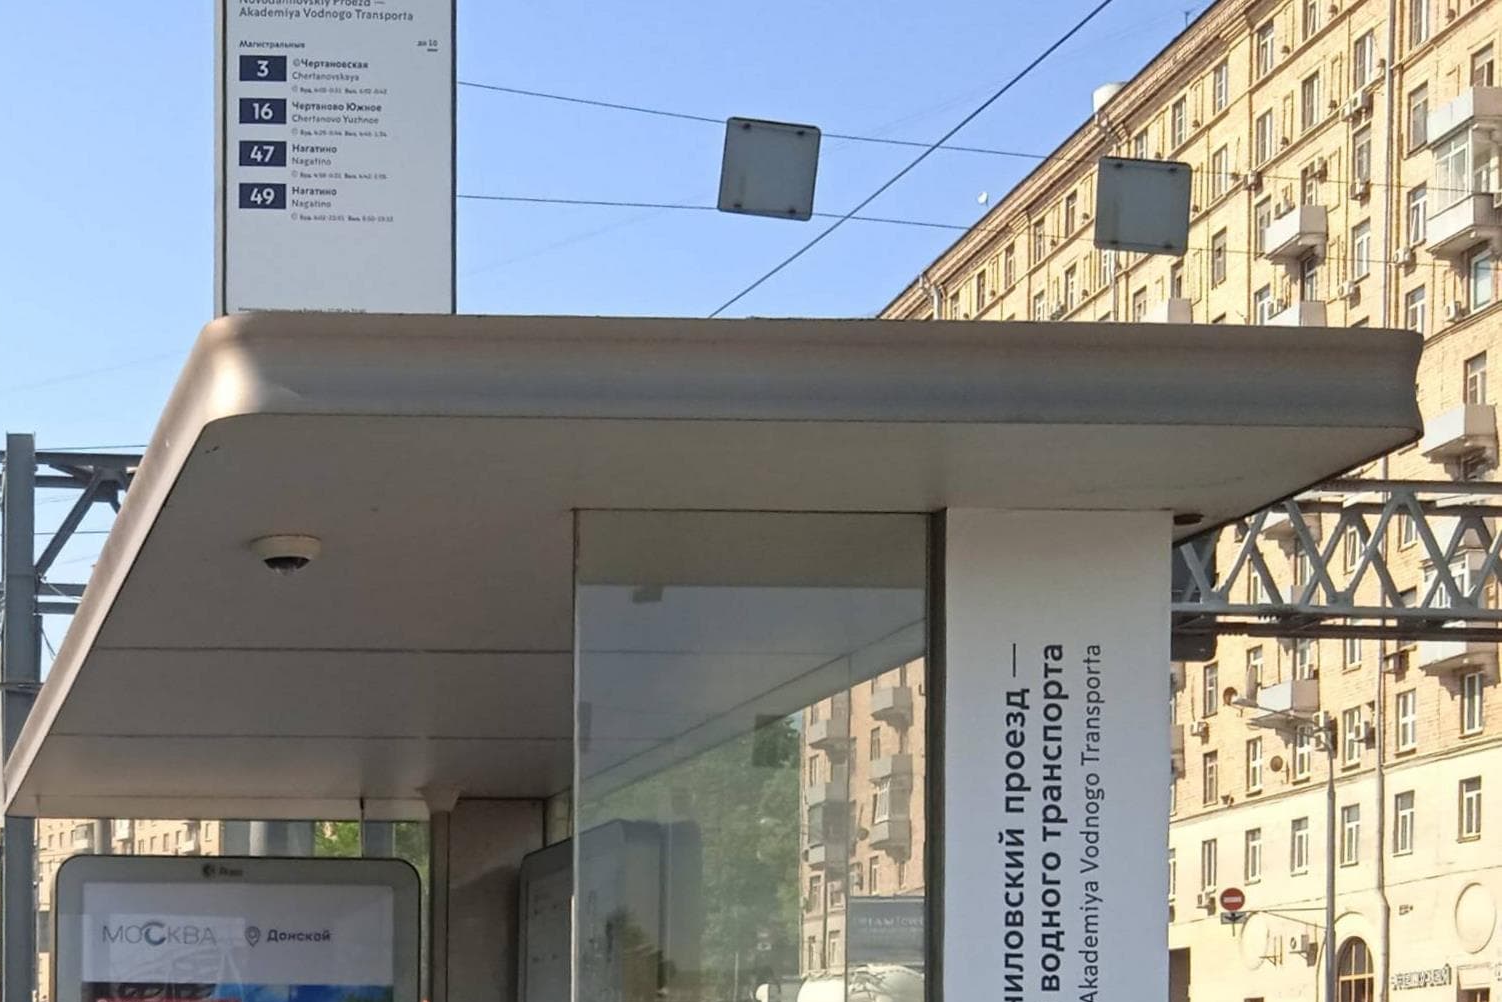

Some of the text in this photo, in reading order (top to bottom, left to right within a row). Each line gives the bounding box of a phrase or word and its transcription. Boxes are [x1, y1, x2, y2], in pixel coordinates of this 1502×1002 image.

[239, 8, 413, 22] Akademiya Vodnogo Transporta
[257, 60, 269, 77] 3
[301, 59, 368, 70] Чертановская
[292, 71, 359, 82] Chertanovskaya
[253, 103, 273, 119] 16
[292, 101, 382, 112] Чертаново Южное
[292, 115, 379, 124] Chertanovo Yuzhnoe
[250, 145, 274, 162] 47
[292, 144, 337, 154] Нагатино
[292, 157, 332, 167] Nagatino
[250, 188, 275, 205] 49
[292, 186, 337, 196] Нагатино
[292, 199, 332, 209] Nagatino
[1081, 644, 1105, 765] Transporta
[1005, 688, 1031, 813] проезд
[1042, 644, 1069, 842] транспорта
[1079, 772, 1104, 874] Vodnogo
[1041, 851, 1065, 991] водного
[102, 921, 217, 946] МОСКВА
[267, 928, 331, 943] Донской
